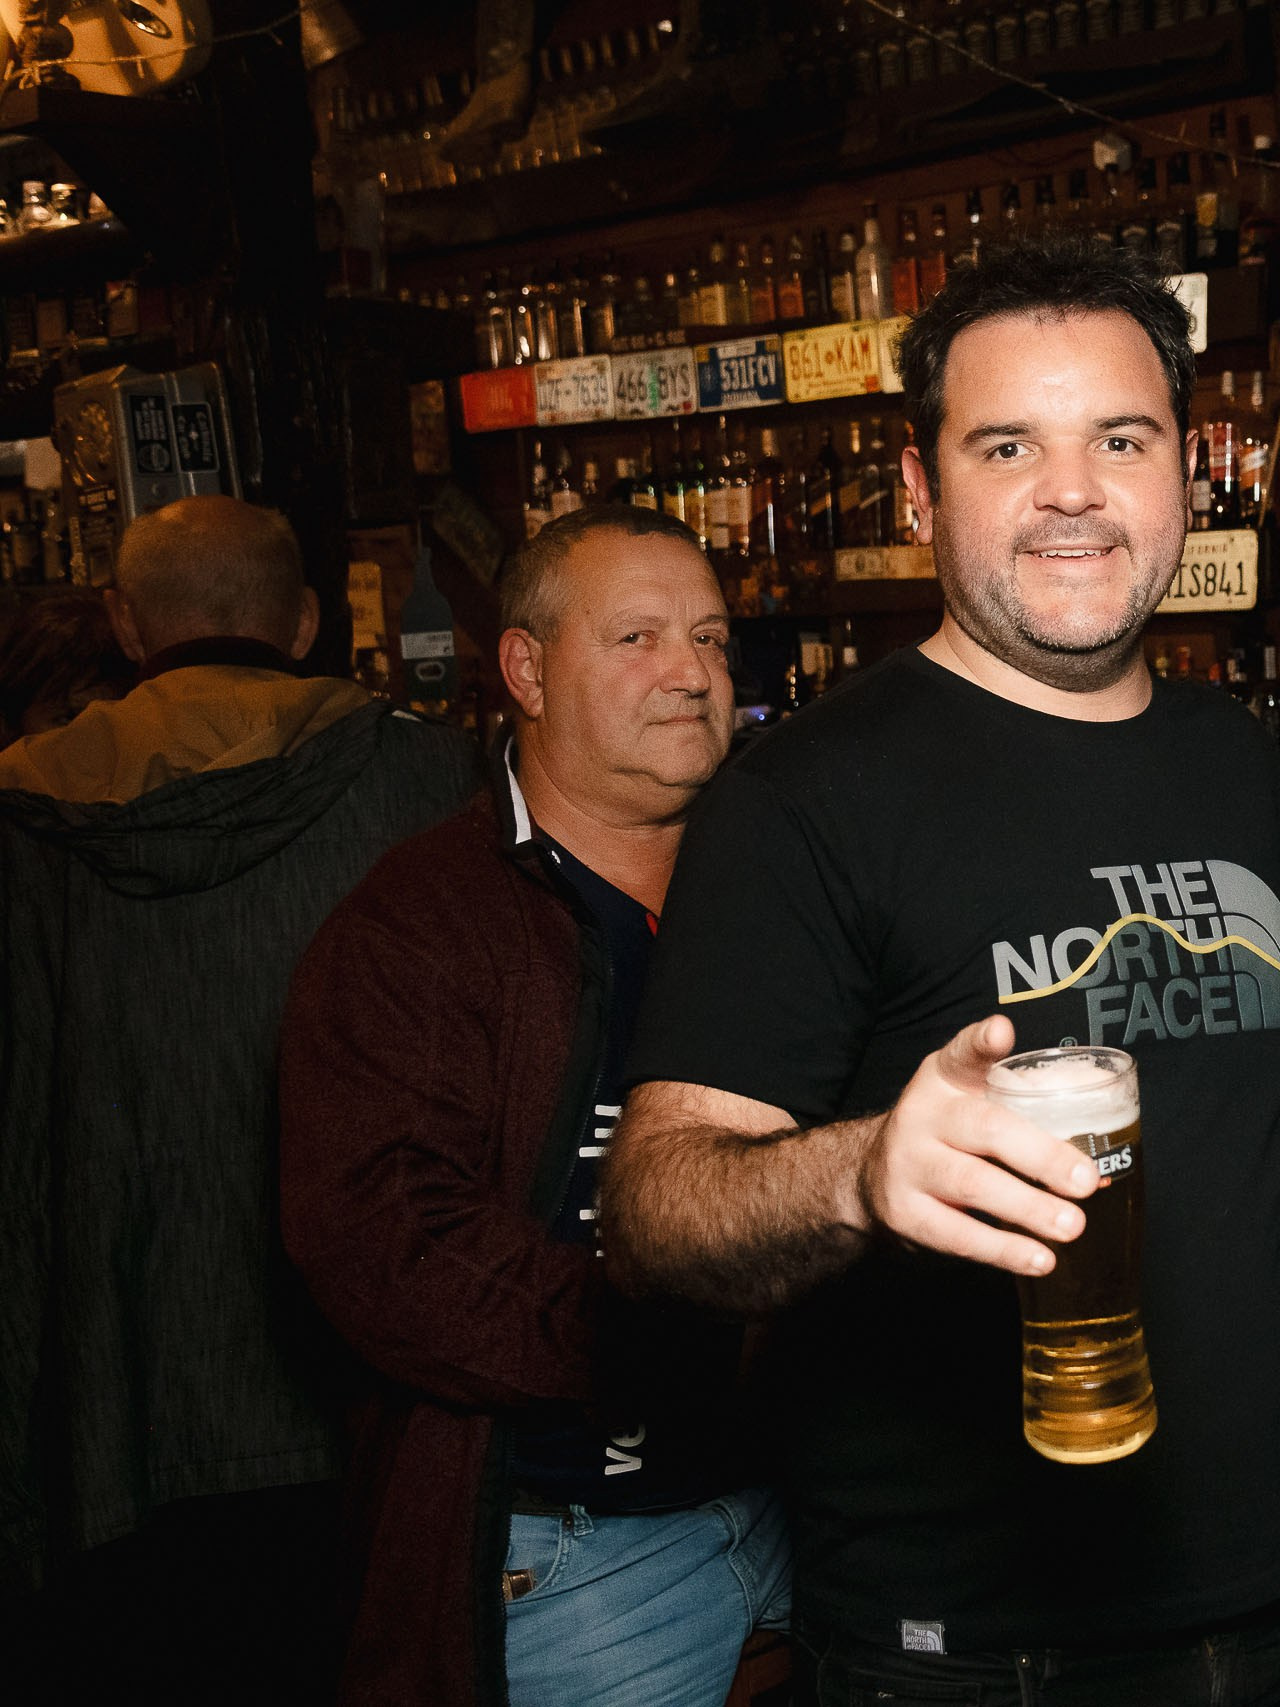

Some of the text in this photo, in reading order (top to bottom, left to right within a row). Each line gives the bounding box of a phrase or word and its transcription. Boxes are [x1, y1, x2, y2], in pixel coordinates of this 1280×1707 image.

[1167, 562, 1247, 598] IS841
[1090, 860, 1217, 919] THE
[991, 914, 1230, 997] NORTH
[1086, 974, 1238, 1047] FACE
